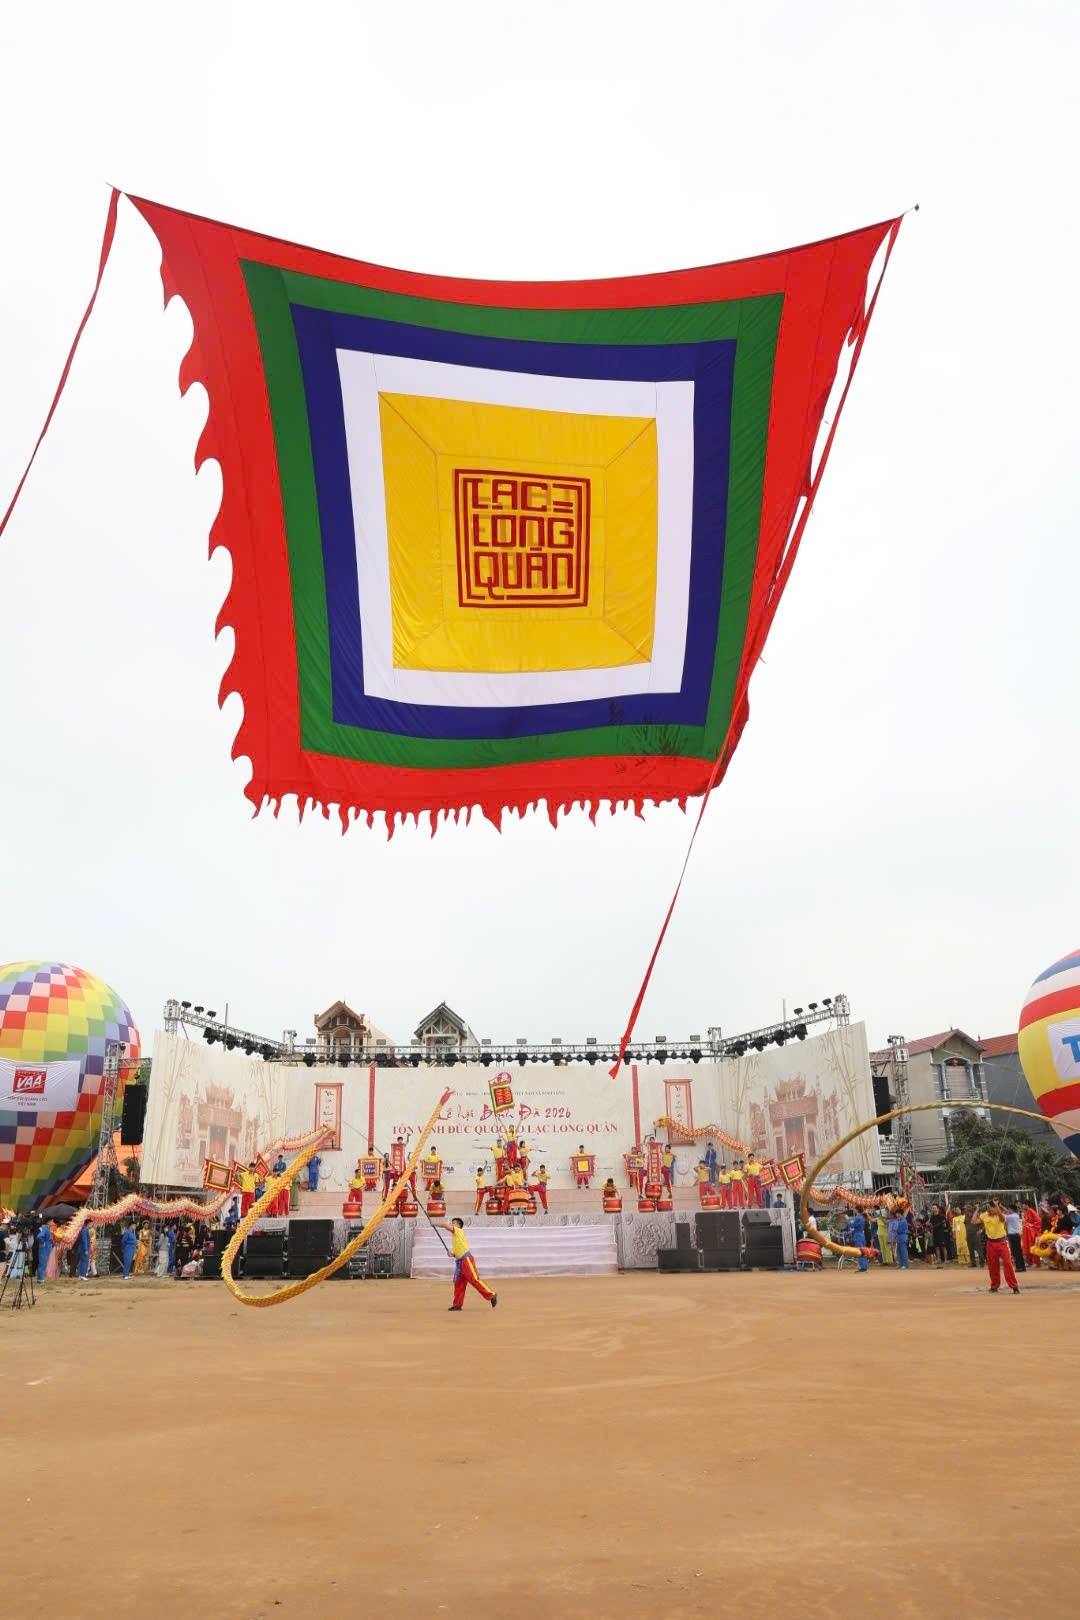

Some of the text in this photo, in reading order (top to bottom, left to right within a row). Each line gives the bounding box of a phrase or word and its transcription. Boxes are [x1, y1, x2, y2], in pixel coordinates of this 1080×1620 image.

[472, 514, 575, 549] LONG
[545, 1107, 571, 1119] 2026
[553, 1124, 583, 1134] LONG
[586, 1121, 618, 1135] QUÂN
